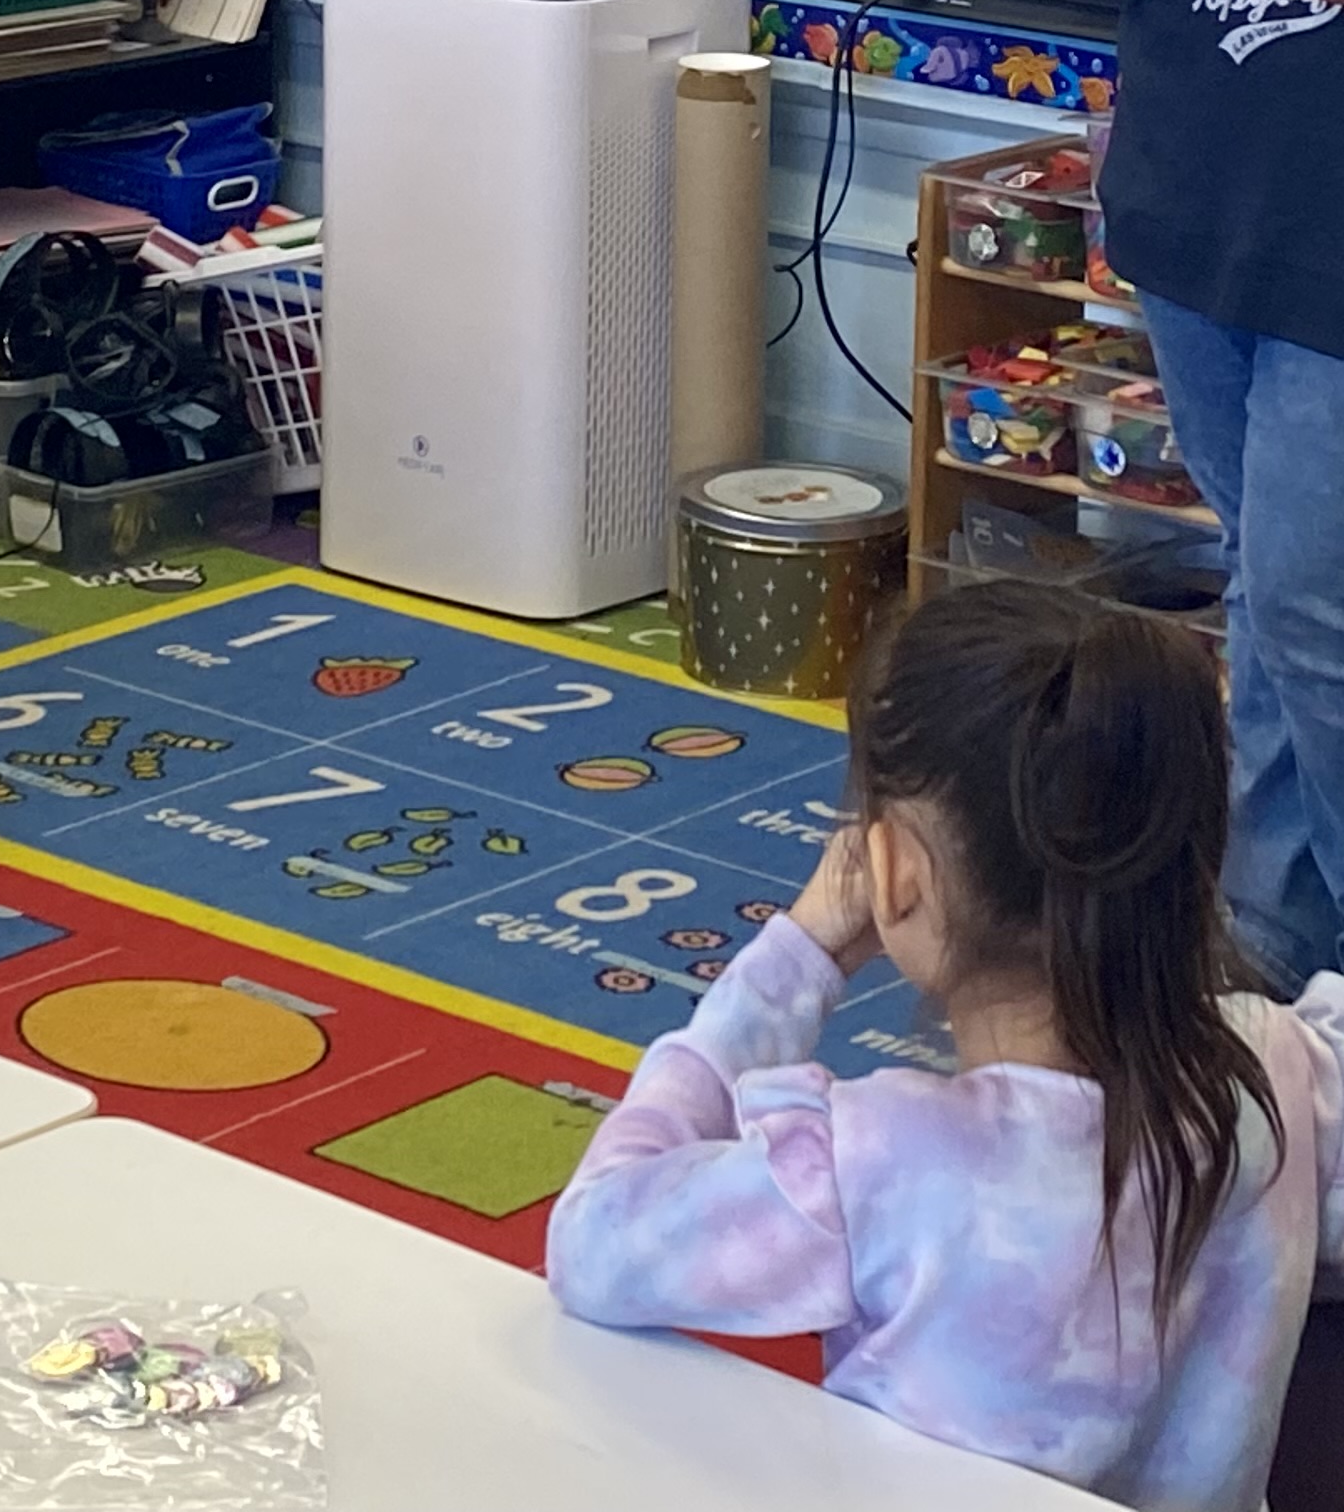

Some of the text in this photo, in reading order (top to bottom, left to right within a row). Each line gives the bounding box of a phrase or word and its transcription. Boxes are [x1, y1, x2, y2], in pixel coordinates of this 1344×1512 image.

[227, 613, 338, 648] 1
[156, 642, 231, 670] one
[476, 682, 615, 733] 2
[431, 720, 513, 750] two
[227, 765, 388, 812] 7
[143, 806, 271, 852] seven
[555, 867, 698, 923] 8
[475, 910, 602, 957] eight
